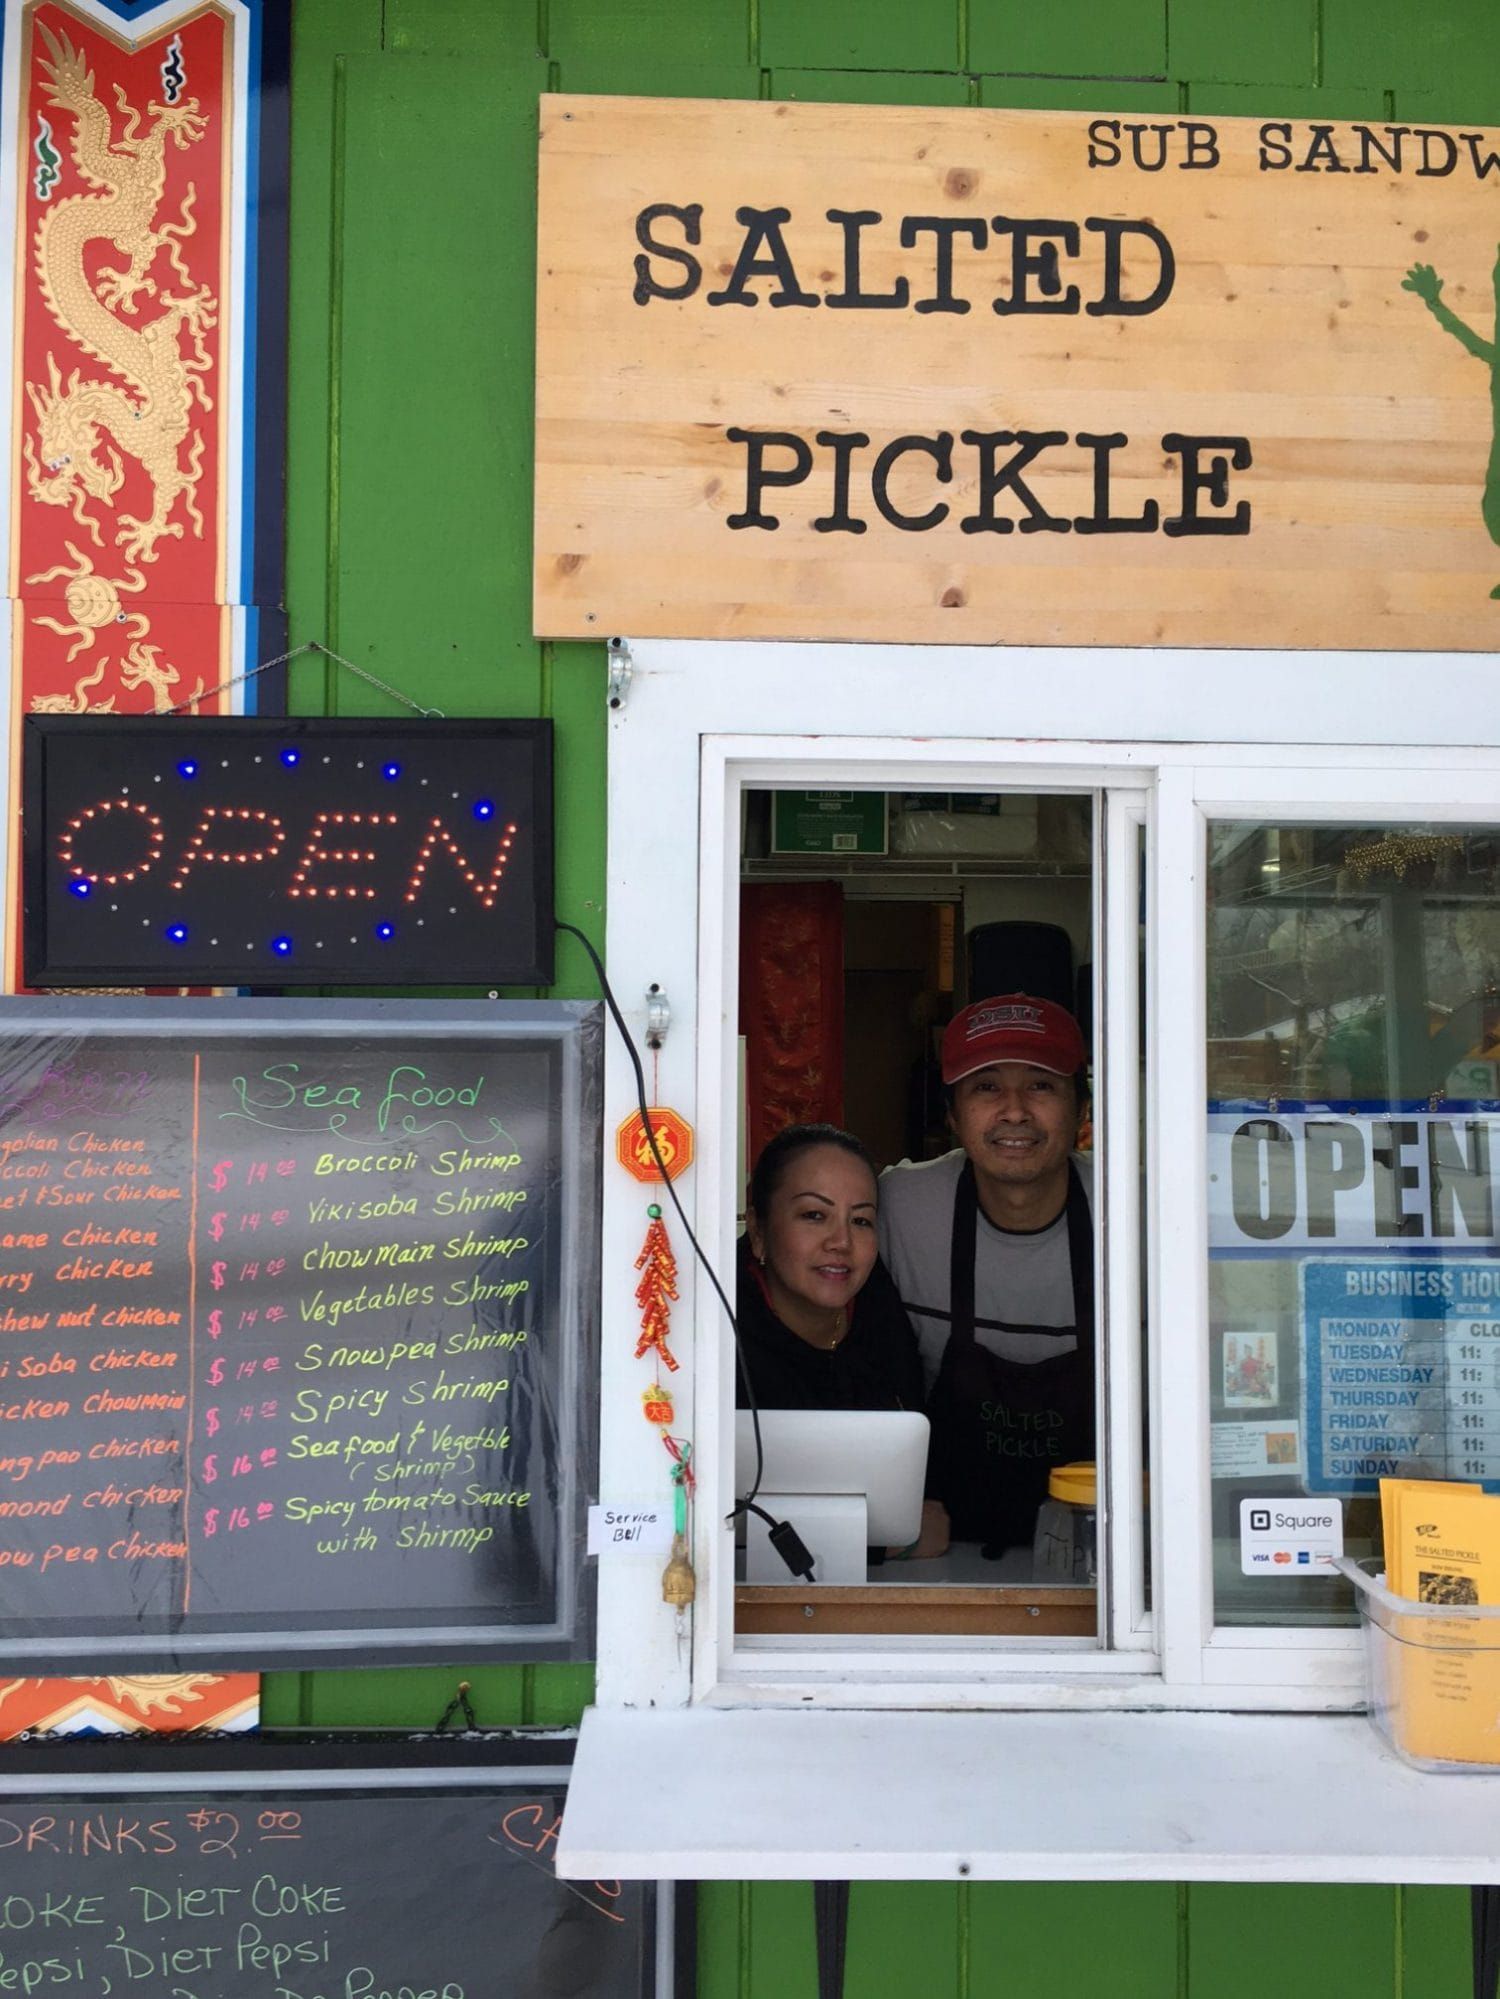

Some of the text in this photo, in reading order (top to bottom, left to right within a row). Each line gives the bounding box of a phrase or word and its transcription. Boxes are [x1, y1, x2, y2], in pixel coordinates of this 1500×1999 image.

[1088, 120, 1220, 171] SUB
[633, 203, 1176, 316] SALTED
[726, 427, 1252, 537] PICKLE
[58, 800, 518, 909] OPEN
[314, 1154, 419, 1176] Broccoli
[431, 1150, 522, 1176] Shrimp
[1230, 1119, 1494, 1240] OPEN
[434, 1189, 528, 1216] Shrimp
[443, 1231, 529, 1259] Shrimp
[1346, 1270, 1454, 1297] BUSINESS
[300, 1282, 434, 1326] Vegetables
[443, 1275, 529, 1306] Shrimp
[444, 1324, 528, 1353] Shrimp
[1328, 1322, 1402, 1337] MONDAY
[1328, 1344, 1404, 1360] TUESDAY
[1329, 1368, 1434, 1384] WEDNESDAY
[290, 1389, 388, 1423] Spicy
[402, 1370, 509, 1405] Shrimp
[1330, 1391, 1420, 1406] THURSDAY
[980, 1400, 1065, 1432] SALTED
[1329, 1414, 1389, 1430] FRIDAY
[984, 1431, 1061, 1459] PICKLE
[1330, 1437, 1420, 1453] SATURDAY
[1330, 1460, 1400, 1475] SUNDAY
[285, 1497, 356, 1528] Spicy
[461, 1484, 530, 1508] Sauce
[604, 1511, 658, 1525] Service
[612, 1525, 642, 1543] Bell
[1275, 1512, 1334, 1532] Square
[316, 1527, 378, 1555] with
[1428, 1546, 1456, 1558] SALTED
[1455, 1550, 1480, 1561] PICKLE
[1252, 1554, 1271, 1562] VISA
[237, 1922, 329, 1980] Pepsi
